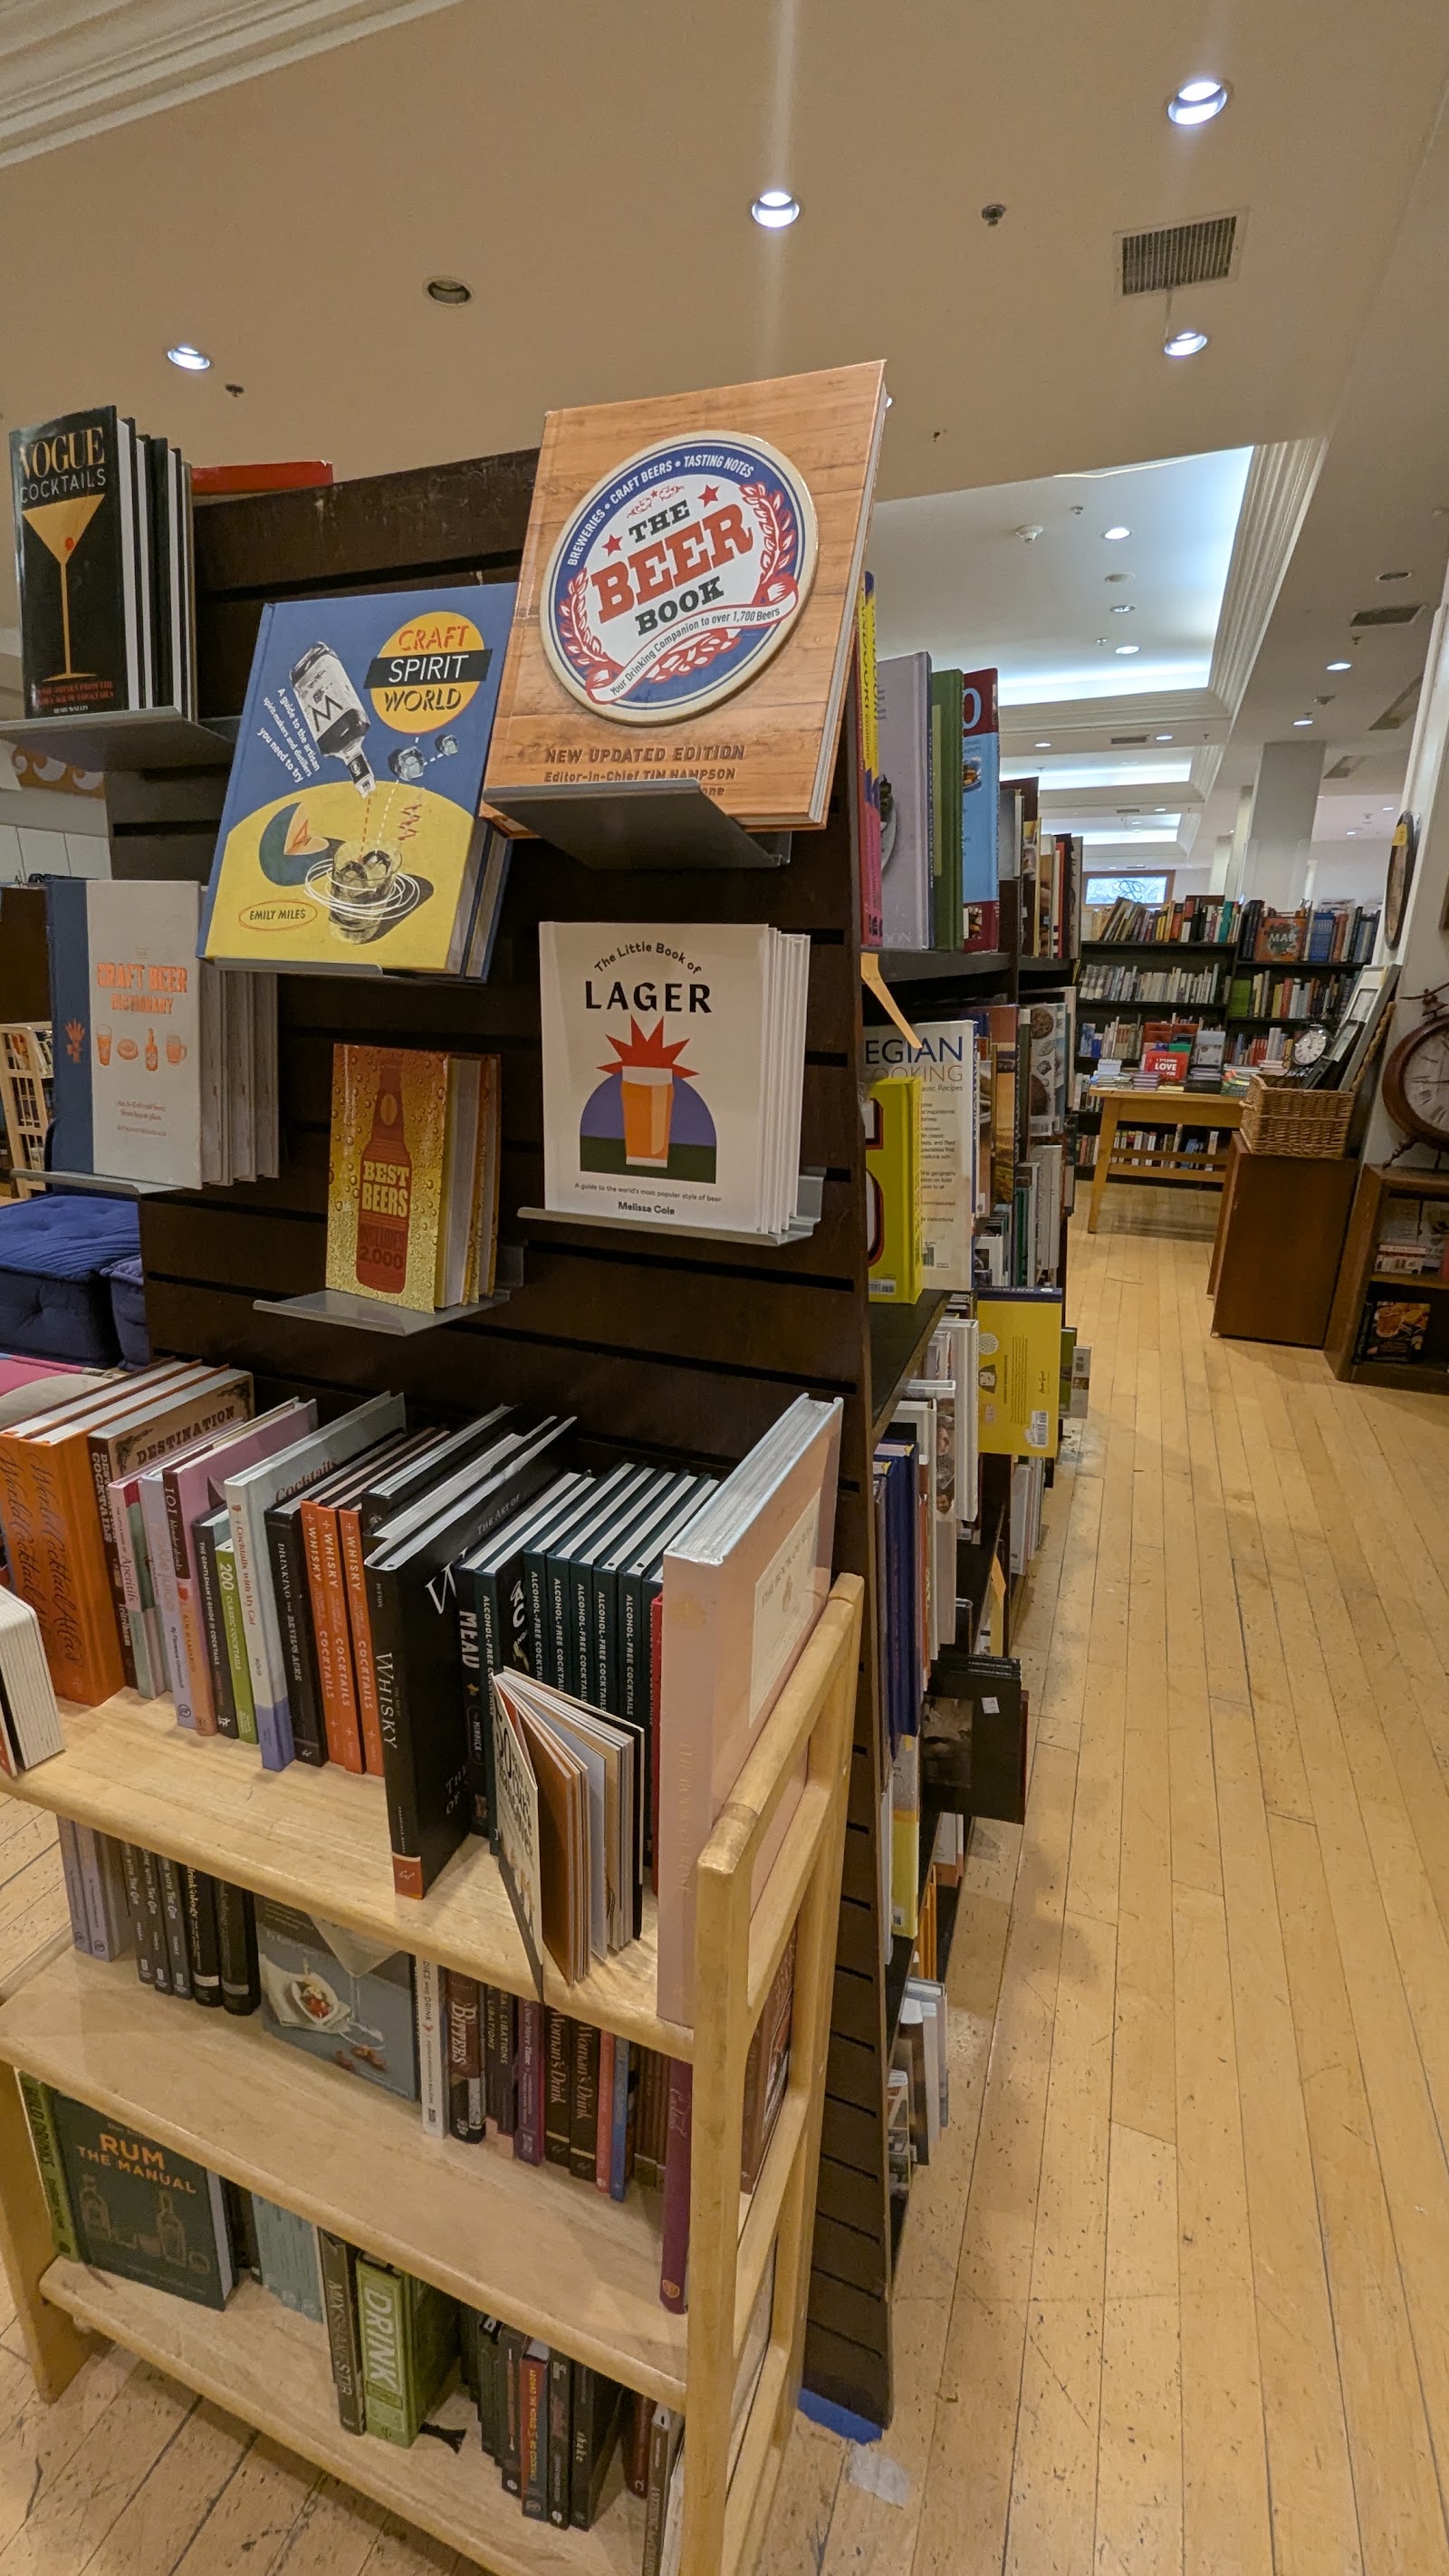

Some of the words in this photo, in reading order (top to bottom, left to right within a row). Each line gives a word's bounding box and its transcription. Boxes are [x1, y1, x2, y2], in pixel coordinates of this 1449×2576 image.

[20, 427, 105, 481] VOGUE
[20, 469, 106, 503] COCKTAILS
[567, 509, 606, 566] BREWERIES
[610, 476, 638, 505] CRAFT
[641, 461, 673, 484] BEERS
[684, 454, 724, 467] TASTING
[724, 457, 754, 478] NOTES
[629, 499, 691, 543] THE
[590, 503, 754, 624] BEER
[635, 575, 724, 637] BOOK
[397, 624, 470, 651] CRAFT
[609, 678, 627, 696] Your
[625, 650, 657, 683] Drinking
[654, 620, 700, 653] Companion
[700, 617, 710, 627] to
[711, 612, 730, 625] over
[733, 610, 756, 623] 1,700
[756, 607, 781, 621] Beers
[388, 654, 470, 683] SPIRIT
[277, 688, 286, 697] A
[279, 697, 295, 718] guide
[384, 687, 462, 713] WORLD
[264, 697, 289, 737] spirit-makers
[286, 737, 298, 750] and
[294, 749, 312, 777] distillers
[292, 718, 301, 729] to
[297, 728, 307, 743] the
[257, 727, 272, 744] you
[270, 742, 289, 762] need
[284, 759, 293, 770] to
[292, 768, 304, 783] try
[303, 744, 321, 772] artisan
[544, 748, 582, 764] NEW
[589, 747, 667, 763] UPDATED
[672, 745, 746, 761] EDITION
[644, 770, 667, 780] TIM
[669, 768, 736, 780] HAMPSON
[248, 909, 276, 921] EMILY
[277, 908, 306, 920] MILES
[97, 962, 145, 990] CRAFT
[149, 965, 187, 994] BEER
[594, 955, 616, 972] The
[617, 941, 652, 957] Little
[656, 942, 686, 964] Book
[686, 962, 702, 974] of
[111, 994, 174, 1014] DICTIONARY
[585, 981, 713, 1014] LAGER
[866, 1036, 964, 1064] EGIAN
[1154, 1062, 1177, 1071] LOVE
[872, 1065, 964, 1082] OOKING
[363, 1159, 409, 1185] BEST
[581, 1183, 597, 1191] guide
[657, 1190, 680, 1199] popular
[362, 1182, 408, 1217] BEERS
[618, 1201, 652, 1213] Melissa
[654, 1206, 675, 1216] Cole
[136, 1405, 236, 1466] DESTINATION
[476, 1516, 494, 1536] THE
[495, 1504, 509, 1524] ART
[509, 1494, 522, 1511] OF
[236, 1526, 247, 1570] Cocktails
[243, 1572, 251, 1591] with
[307, 1527, 322, 1581] WHISKY
[324, 1533, 338, 1588] WHISKY
[347, 1536, 361, 1591] WHISKY
[121, 1557, 137, 1603] Aperitifs
[219, 1562, 235, 1591] 200
[206, 1600, 216, 1622] GUIDE
[531, 1571, 542, 1639] ALCOHOL-FREE
[554, 1578, 563, 1647] ALCOHOL-FREE
[578, 1583, 586, 1653] ALCOHOL-FREE
[210, 1629, 221, 1667] COCKTAILS
[459, 1610, 480, 1668] MEAD
[483, 1595, 494, 1666] ALCOHOL-FREE
[626, 1594, 634, 1665] ALCOHOL-FREE
[319, 1630, 334, 1698] COCKTAILS
[335, 1638, 350, 1707] COCKTAILS
[359, 1641, 373, 1710] COCKTAILS
[534, 1640, 543, 1682] COCKTAI
[556, 1647, 565, 1691] COCKTAIL
[375, 1652, 398, 1749] WHISKY
[599, 1659, 607, 1711] COCKTAILS
[452, 2001, 477, 2065] BITTERS
[487, 1999, 495, 2050] LIBATIONS
[500, 2014, 508, 2064] LIBATIONS
[550, 2012, 566, 2068] Woman's
[577, 2026, 592, 2084] Woman's
[551, 2070, 566, 2103] Drink
[577, 2086, 593, 2119] Drink
[76, 2146, 111, 2167] THE
[118, 2161, 197, 2195] MANUAL
[99, 2133, 165, 2169] RUM
[363, 2286, 398, 2392] DRINK
